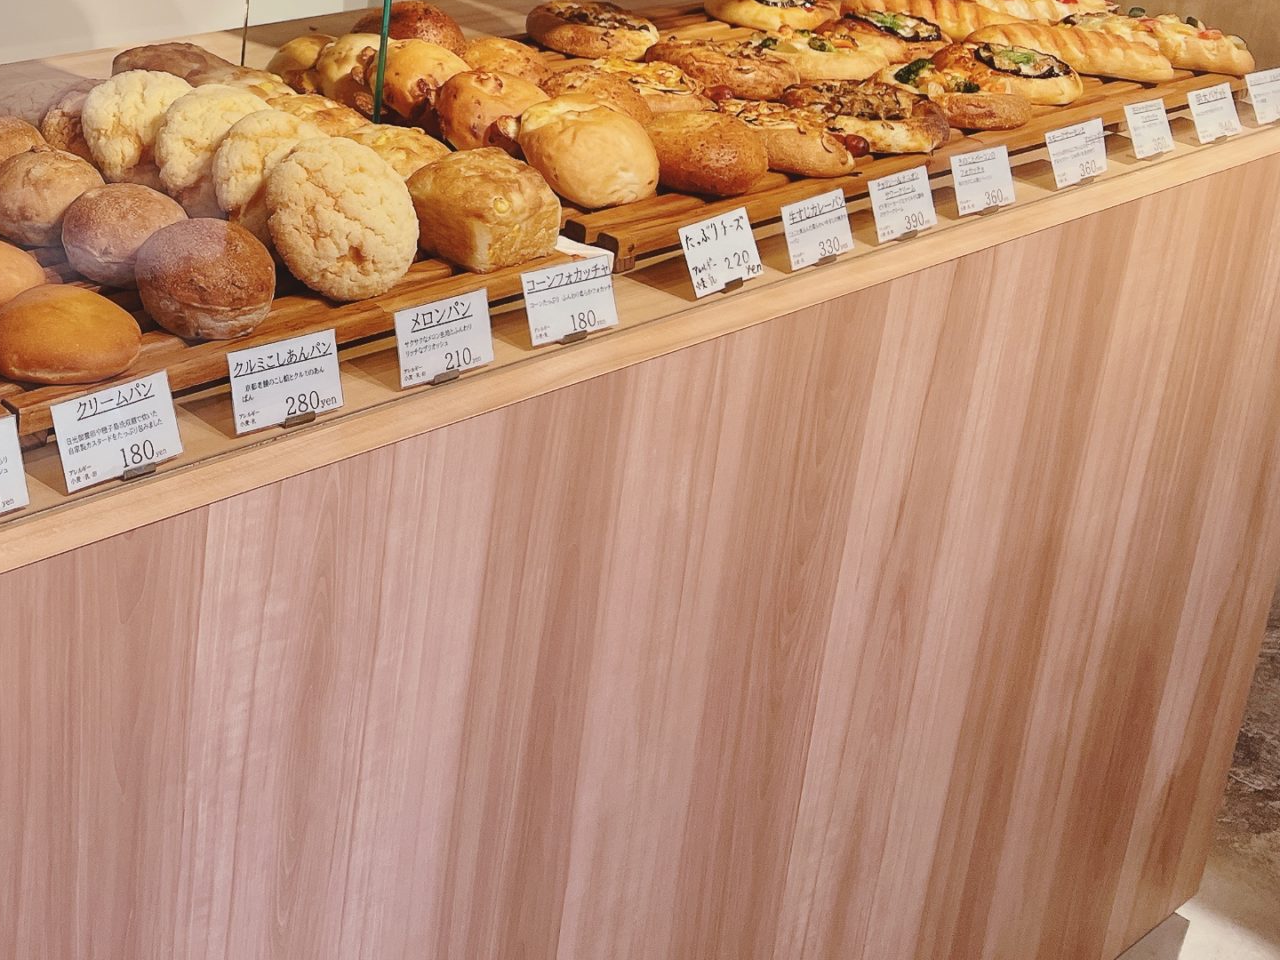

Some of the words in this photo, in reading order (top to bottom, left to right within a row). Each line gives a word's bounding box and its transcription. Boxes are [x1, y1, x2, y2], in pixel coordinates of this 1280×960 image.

[1079, 159, 1096, 177] 360
[788, 195, 845, 223] 牛すじカレーパン
[984, 188, 1003, 206] 360
[904, 210, 925, 231] 390
[818, 236, 840, 256] 330
[724, 250, 750, 270] 220
[526, 263, 609, 292] コーンフォカッチャ
[410, 300, 472, 331] メロンパン
[570, 309, 597, 331] 180
[234, 341, 332, 378] クルミこしあんパン
[444, 346, 472, 371] 210
[76, 381, 153, 421] クリームパン
[285, 390, 320, 416] 280
[320, 395, 337, 408] yen
[68, 418, 164, 456] 自家製カスタードをたっぷり包みました
[120, 439, 155, 469] 180
[1, 498, 15, 508] yen
